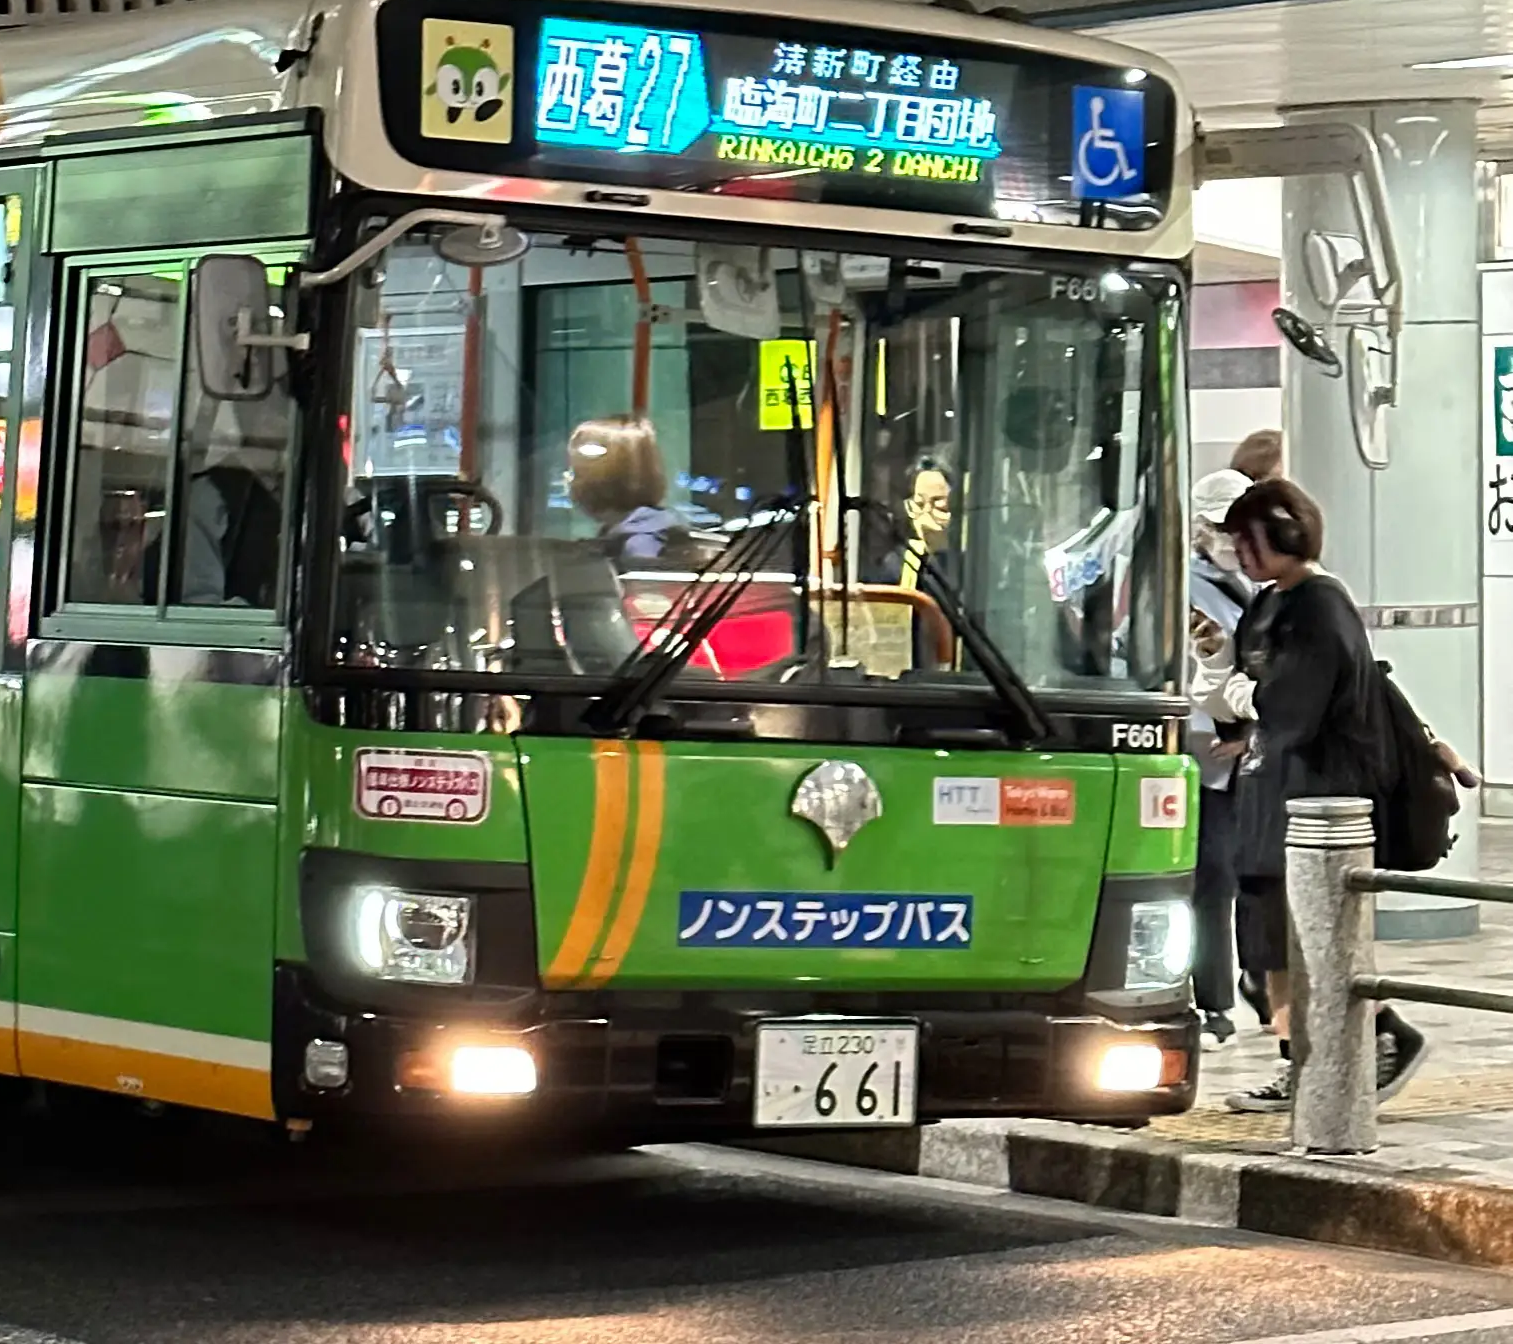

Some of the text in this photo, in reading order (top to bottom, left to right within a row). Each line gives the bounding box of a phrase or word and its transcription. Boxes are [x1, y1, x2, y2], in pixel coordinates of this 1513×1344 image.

[771, 42, 960, 92] 清新町経由
[723, 76, 996, 148] 臨海町二丁目団地
[863, 148, 885, 173] 2
[893, 153, 981, 183] DANCHI
[1112, 723, 1164, 749] F661
[939, 785, 982, 805] HTT
[679, 898, 971, 942] ノンステップバス
